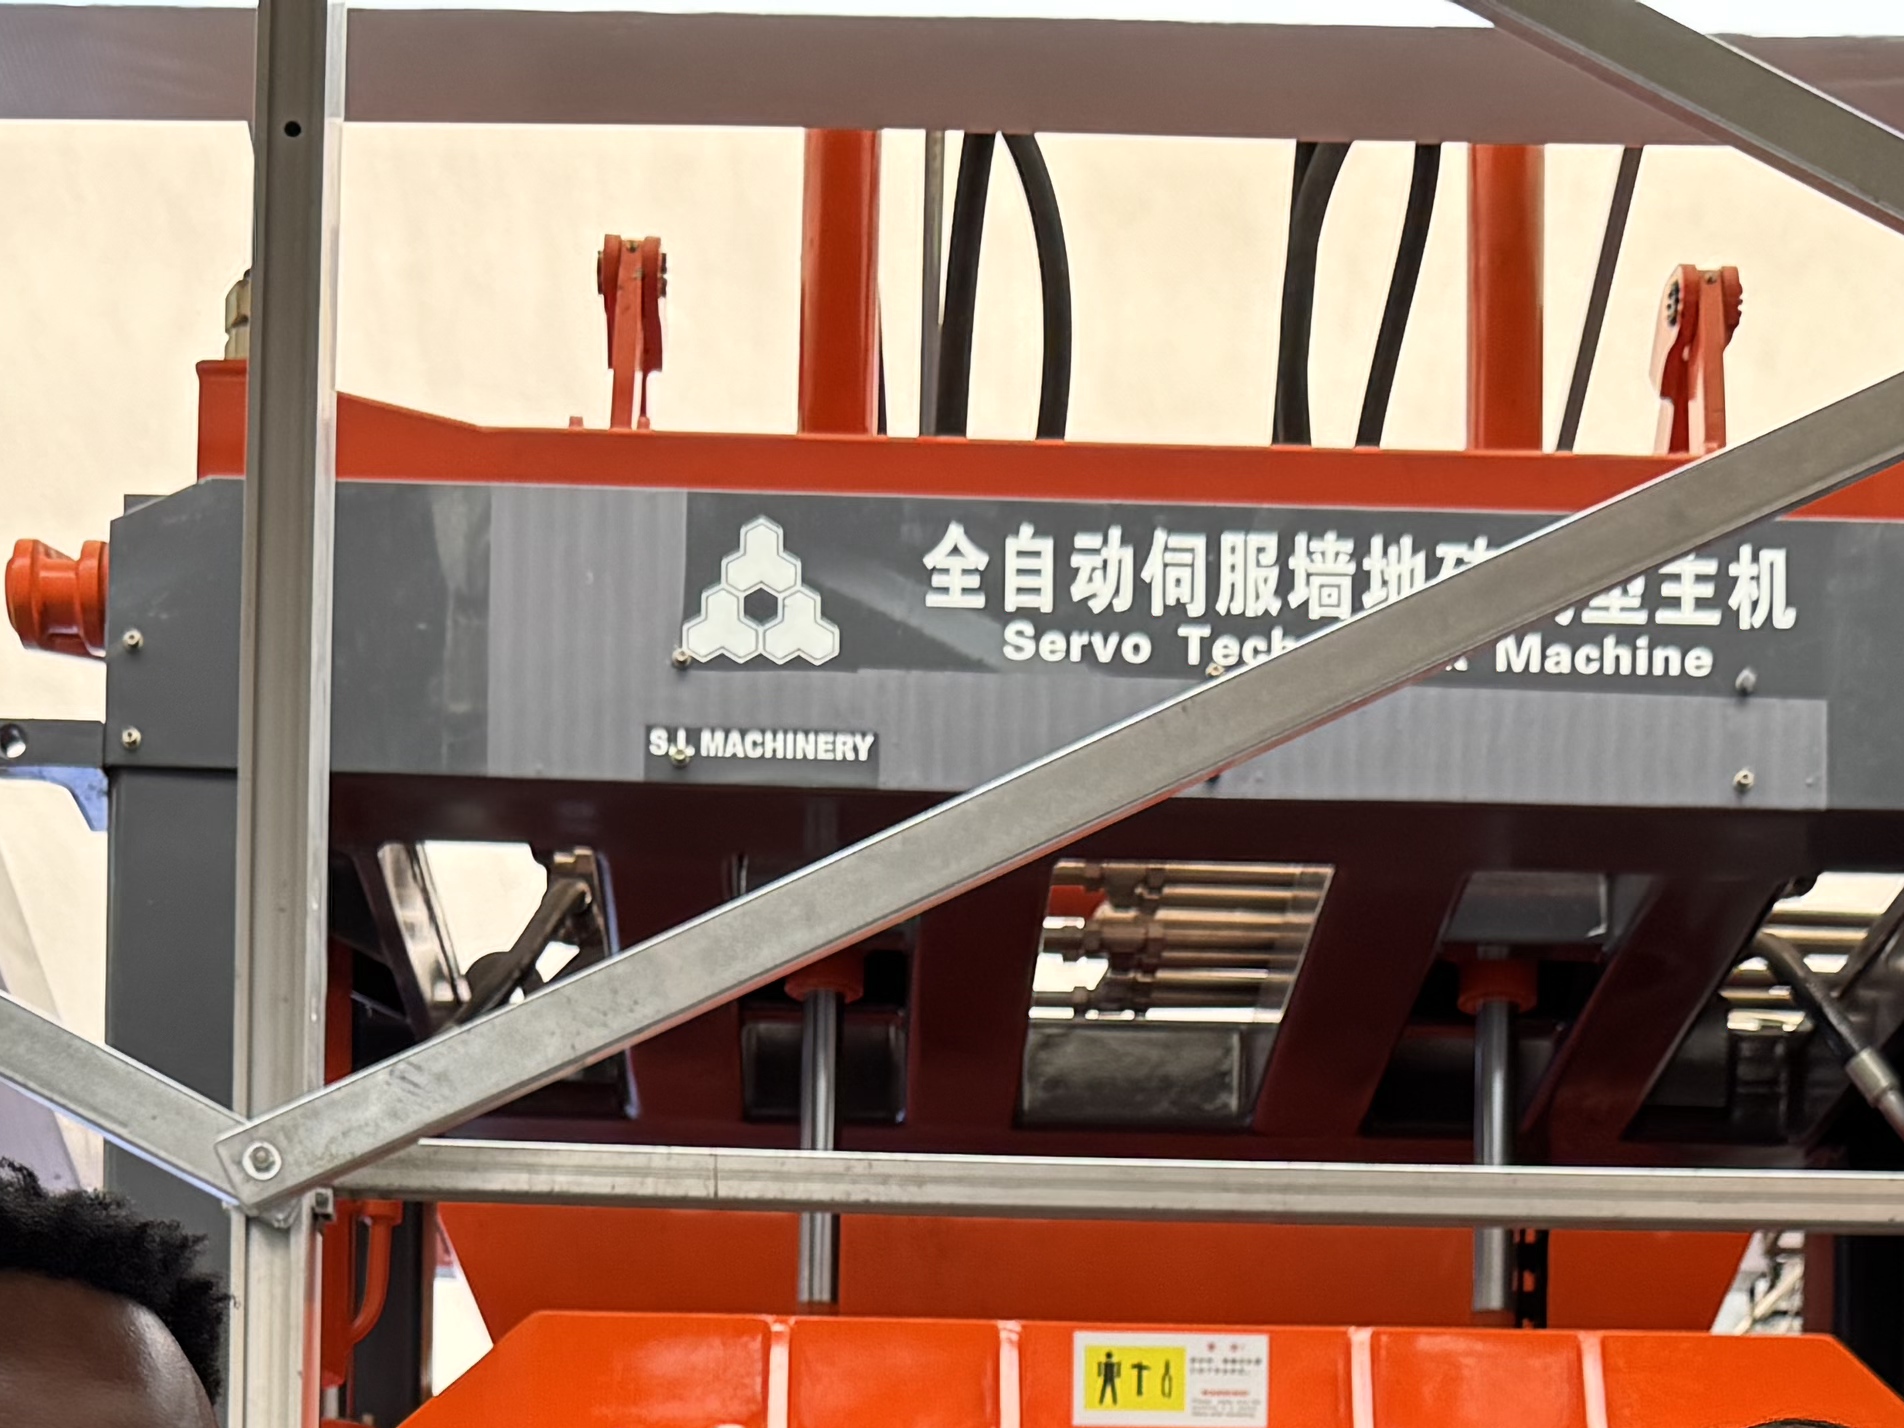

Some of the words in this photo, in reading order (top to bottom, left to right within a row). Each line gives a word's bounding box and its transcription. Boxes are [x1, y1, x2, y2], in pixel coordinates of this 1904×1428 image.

[1003, 620, 1152, 664] Servo
[1495, 633, 1713, 678] Machine
[700, 728, 874, 761] MACHINERY
